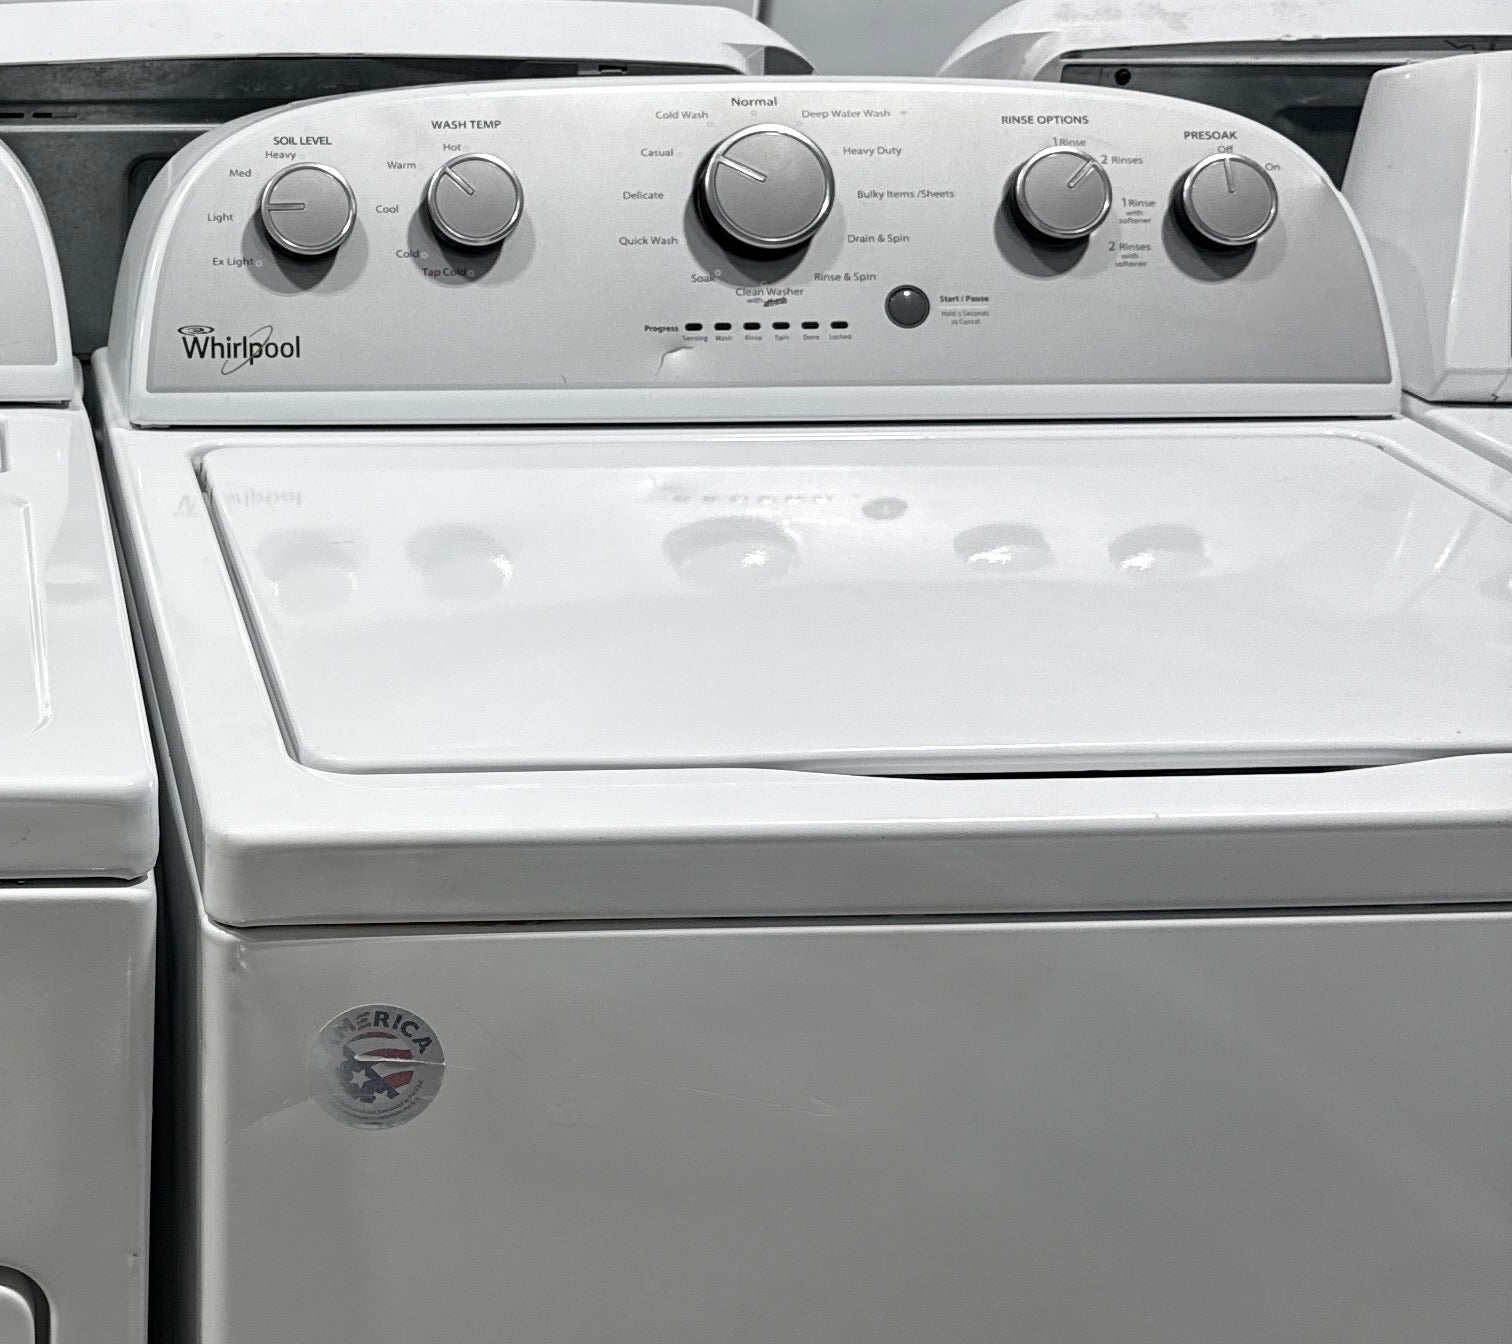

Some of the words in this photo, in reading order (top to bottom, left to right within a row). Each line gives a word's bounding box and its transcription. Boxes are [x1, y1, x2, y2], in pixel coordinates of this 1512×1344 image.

[731, 97, 777, 107] Normal
[655, 111, 678, 119] Cold
[680, 110, 709, 119] Wash
[801, 109, 828, 119] Deep
[830, 109, 860, 118] Water
[863, 109, 891, 118] Wash
[431, 120, 466, 129] WASH
[469, 120, 501, 129] TEMP
[1001, 115, 1034, 125] RINSE
[1037, 115, 1088, 125] OPTIONS
[1184, 131, 1237, 140] PRESOAK
[273, 136, 297, 146] SOIL
[300, 136, 332, 146] LEVEL
[1060, 138, 1086, 147] Rinse
[443, 143, 461, 152] Hot
[640, 148, 674, 157] Casual
[843, 146, 873, 157] Heavy
[876, 145, 902, 157] Duty
[1217, 145, 1233, 154] Off
[265, 150, 296, 162] Heavy
[1101, 155, 1108, 165] 2
[1111, 155, 1143, 165] Rinses
[387, 161, 416, 170] Warm
[1265, 163, 1281, 171] On
[229, 168, 252, 178] Med
[623, 190, 664, 200] Delicate
[857, 190, 885, 200] Bulky
[886, 189, 915, 198] Items
[1128, 198, 1155, 207] Rinse
[375, 204, 399, 214] Cool
[207, 212, 234, 224] Light
[1119, 216, 1152, 224] softener
[619, 236, 649, 247] Quick
[651, 236, 678, 245] Wash
[847, 234, 875, 244] Drain
[877, 234, 885, 244] &
[887, 234, 910, 244] Spin
[1108, 242, 1116, 252] 2
[1119, 242, 1151, 252] Rinses
[396, 248, 420, 258] Cold
[212, 258, 227, 267] Ex
[230, 256, 254, 268] Light
[1114, 259, 1147, 267] softener
[422, 268, 441, 279] Tap
[443, 267, 467, 277] Cold
[691, 273, 716, 283] Soak
[814, 272, 841, 281] Rinse
[843, 272, 852, 282] &
[853, 272, 877, 282] Spin
[735, 287, 764, 297] Clean
[766, 287, 804, 297] Washer
[939, 295, 960, 303] Start
[965, 295, 989, 303] Pause
[644, 324, 679, 333] Progress
[682, 335, 708, 343] Sensing
[774, 334, 790, 342] Spin
[182, 335, 300, 364] Whirlpool
[331, 1010, 432, 1054] ERICA
